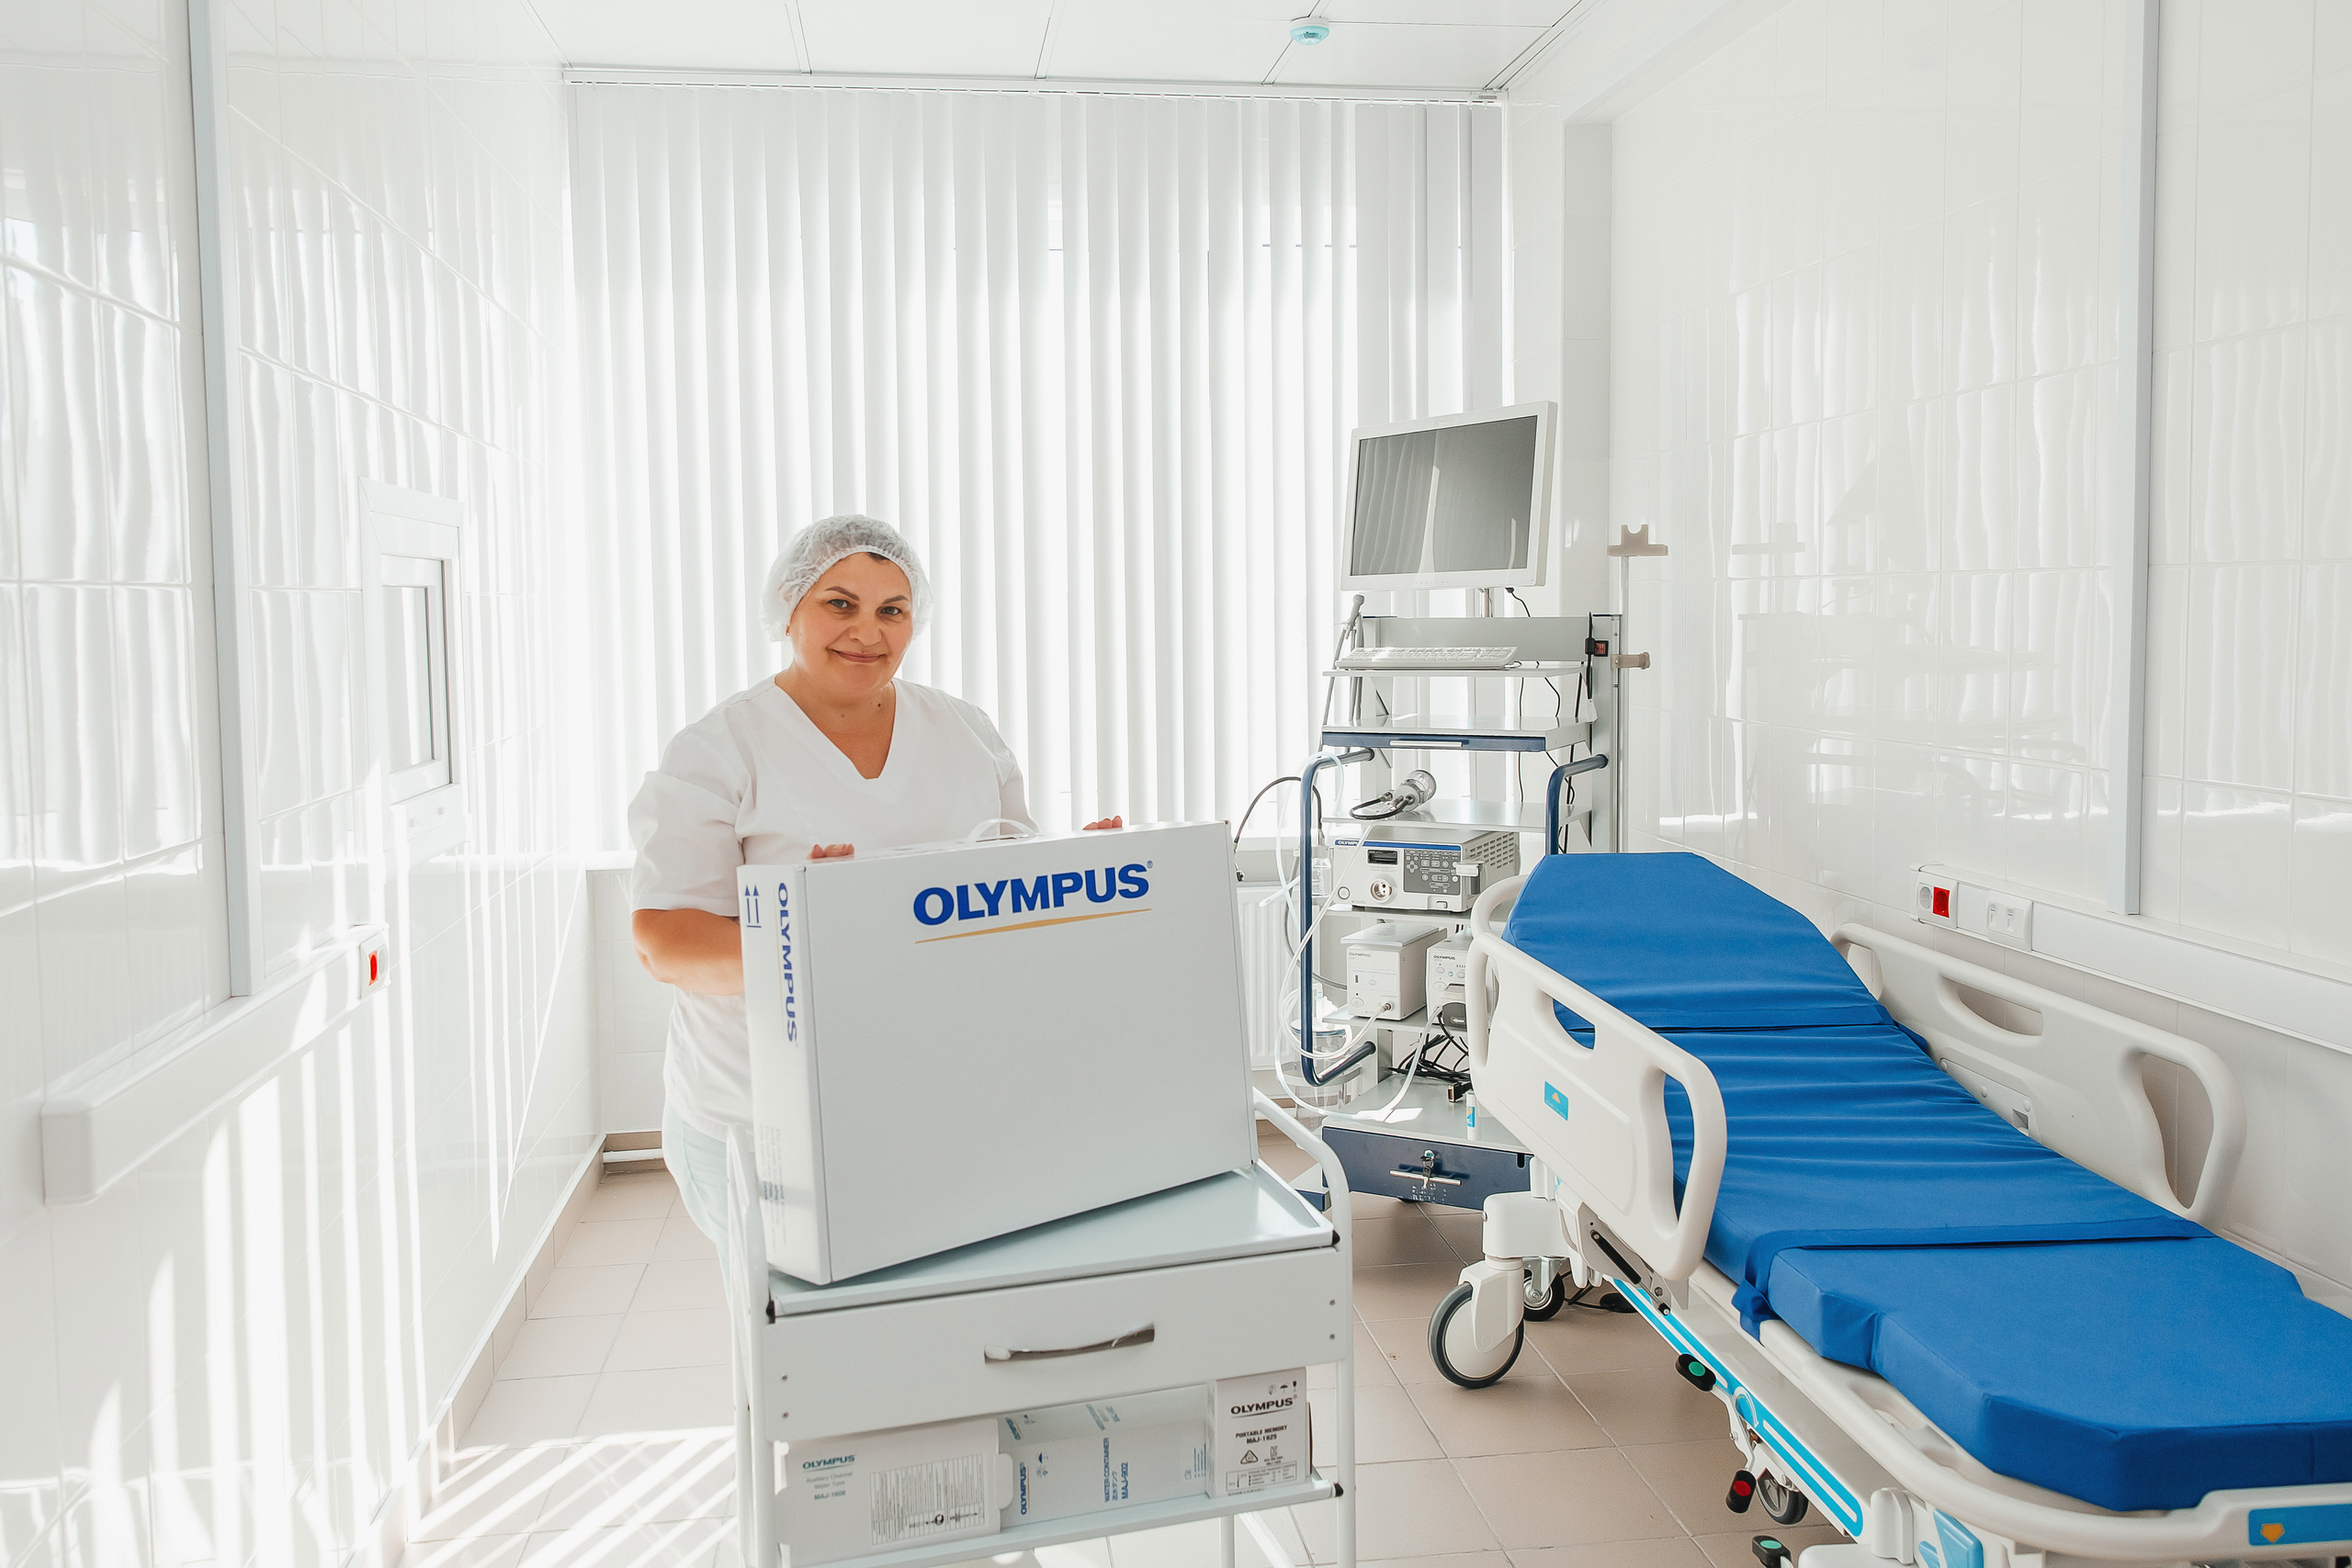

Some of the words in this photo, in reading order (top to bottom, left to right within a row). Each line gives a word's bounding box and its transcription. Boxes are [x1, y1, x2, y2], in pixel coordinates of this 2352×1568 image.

[1235, 1428, 1263, 1438] PORTABLE
[1264, 1425, 1288, 1434] MEMORY
[802, 1454, 855, 1470] OLYMPUS
[1121, 1462, 1129, 1500] MAJ-902
